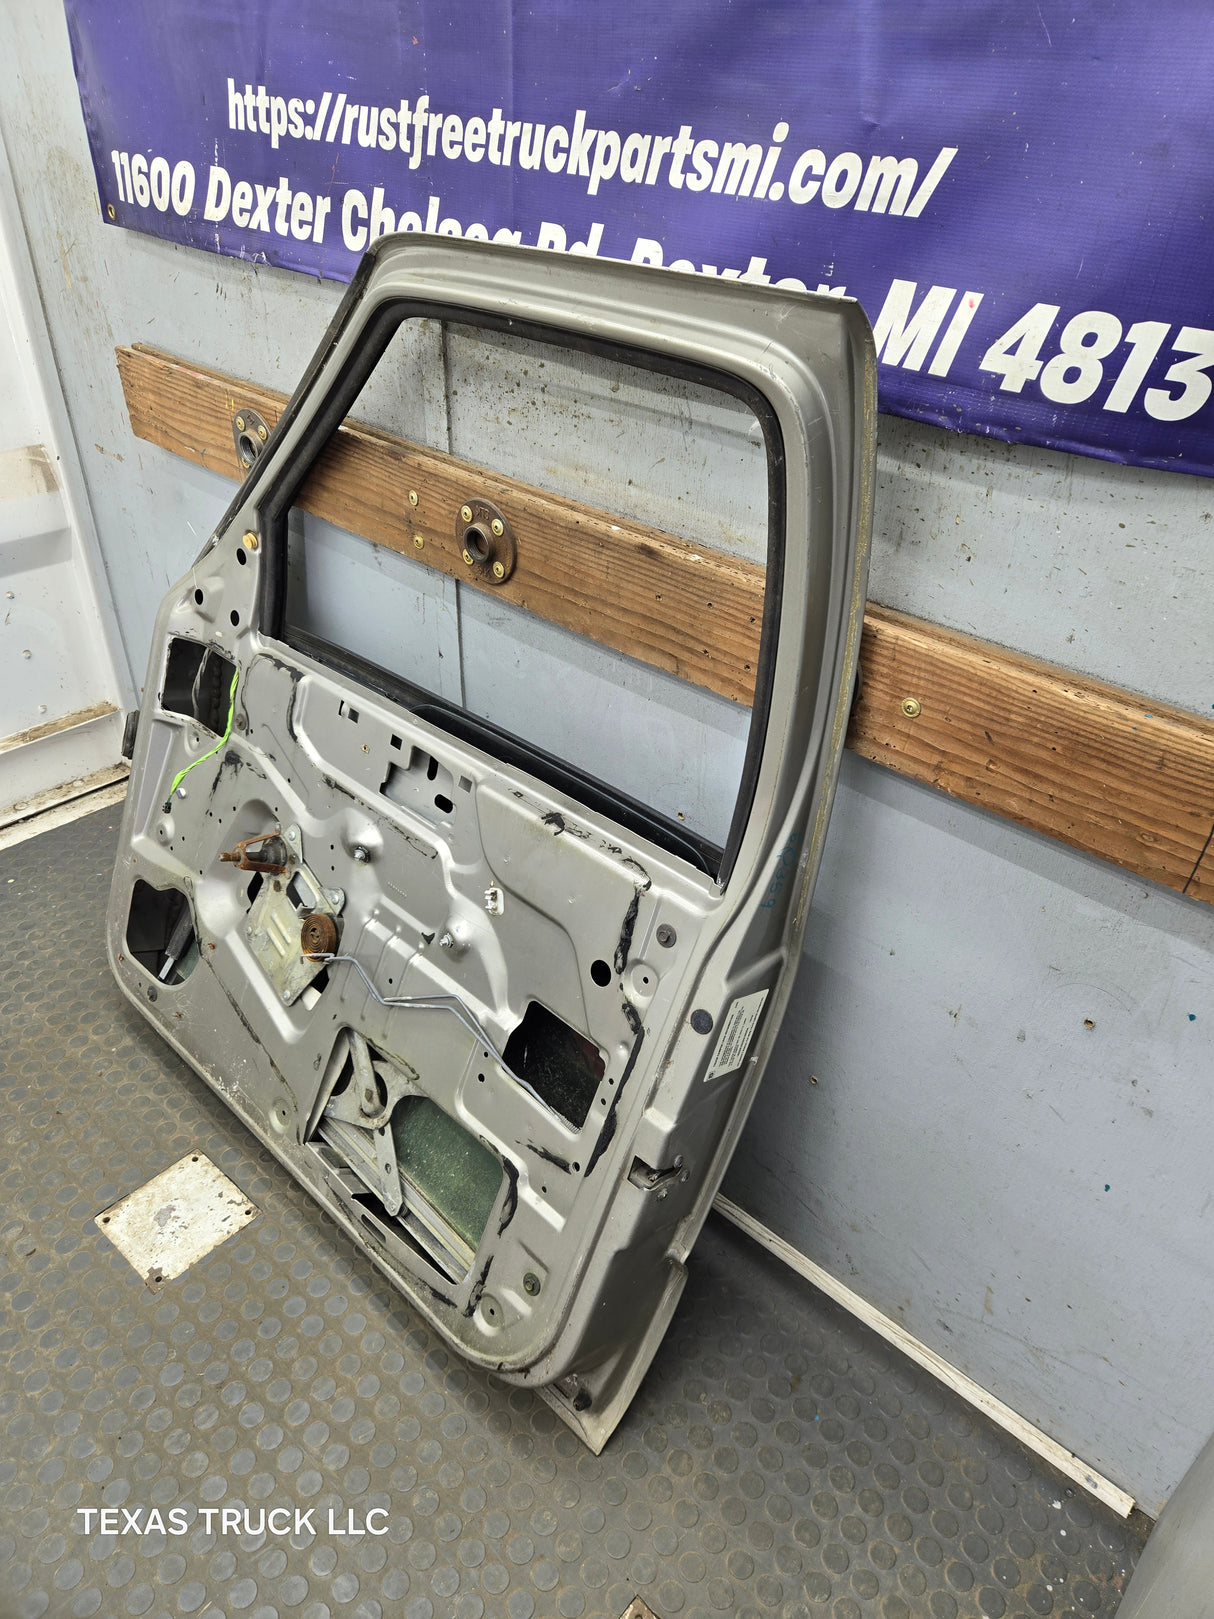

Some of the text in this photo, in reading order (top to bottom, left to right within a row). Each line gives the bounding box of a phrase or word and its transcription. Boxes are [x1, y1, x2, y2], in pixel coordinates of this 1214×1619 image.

[226, 77, 958, 217] https://rustfreetruckpartsmi.com/
[110, 149, 196, 217] 11600
[203, 164, 332, 246] Dexter
[873, 279, 985, 378] MI
